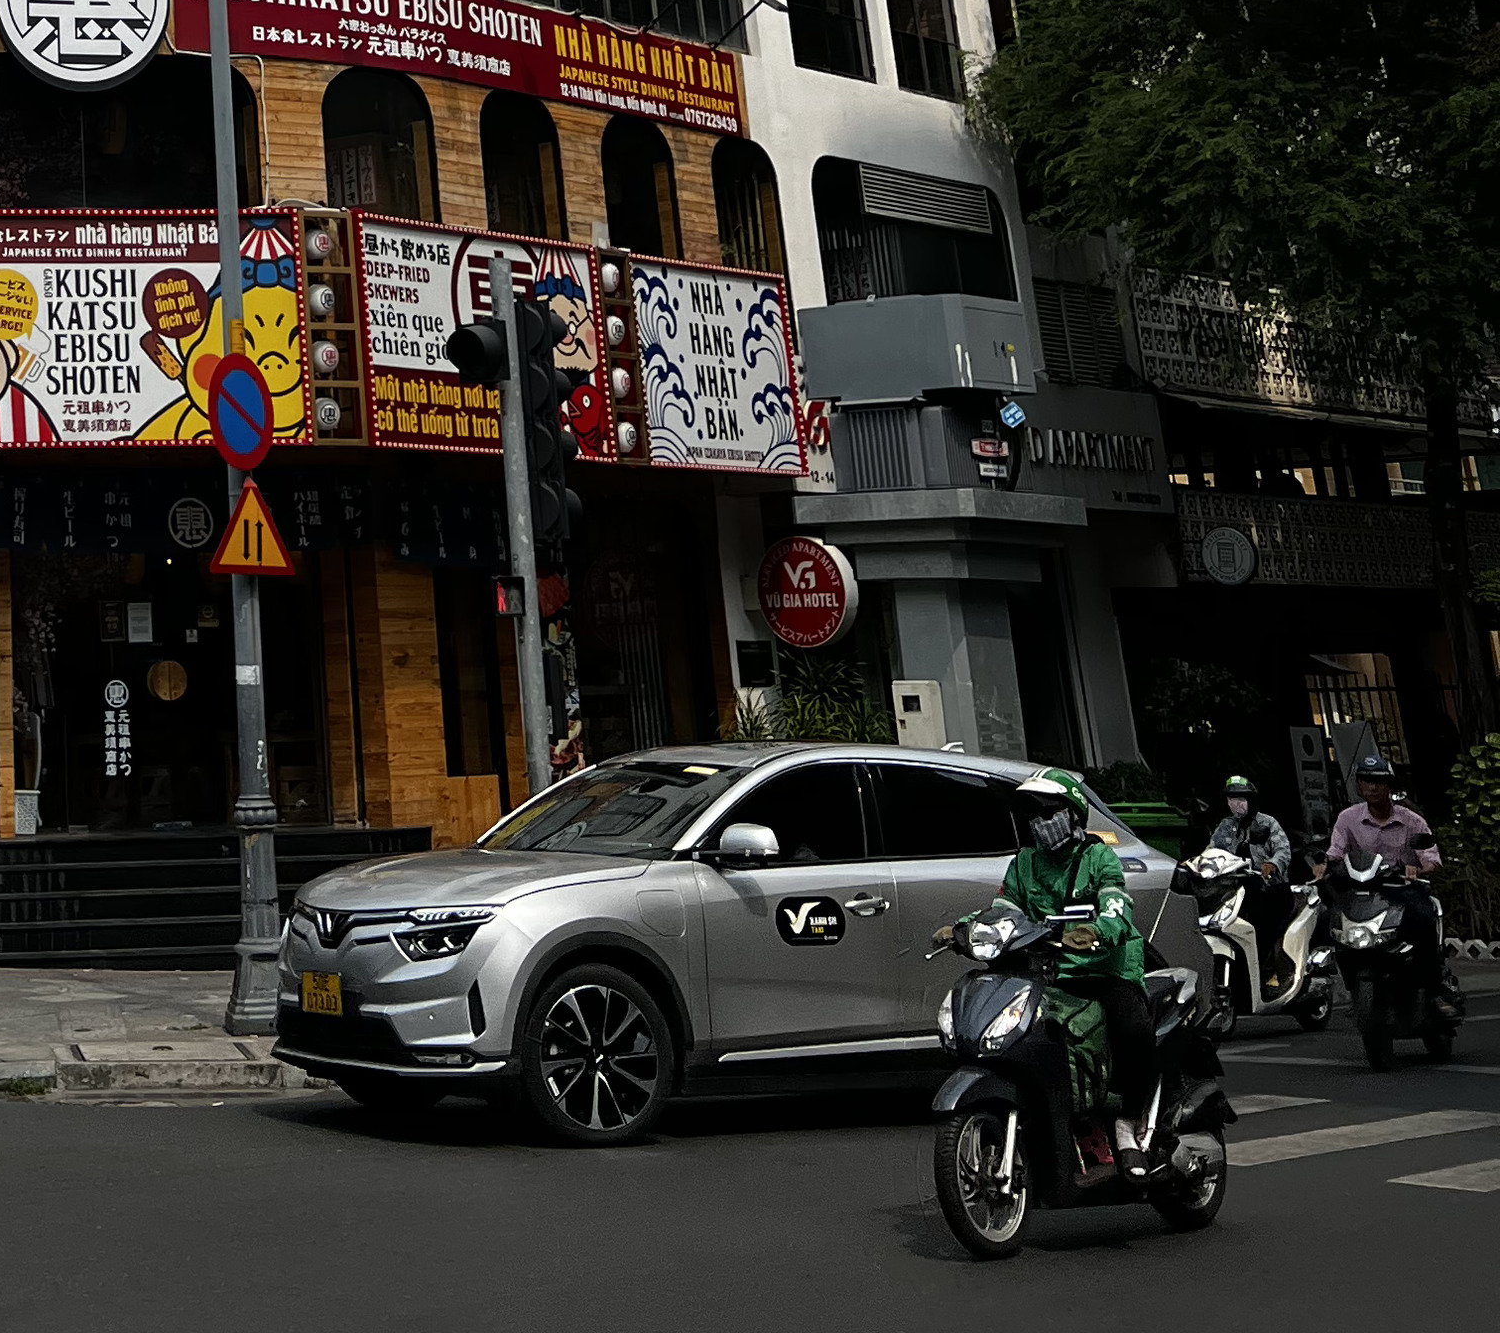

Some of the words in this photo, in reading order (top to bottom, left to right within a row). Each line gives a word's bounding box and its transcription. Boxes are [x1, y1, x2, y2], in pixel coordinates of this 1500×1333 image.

[400, 26, 447, 44] パラダイス
[468, 2, 544, 47] SHOTEN
[252, 25, 363, 50] 日本食レストラン
[367, 36, 442, 63] 元祖串かつ
[553, 23, 593, 63] NHÀ
[596, 31, 647, 75] HÀNG
[650, 45, 695, 89] NHẬT
[699, 51, 733, 95] BẢN
[559, 64, 610, 87] JAPANESE
[611, 76, 639, 94] STYLE
[640, 82, 676, 102] DINING
[677, 90, 735, 115] RESTAURANT
[684, 107, 737, 133] 0767229439
[75, 222, 107, 244] nhà
[111, 222, 151, 246] hàng
[156, 222, 195, 247] Nhật
[199, 220, 219, 244] Bả
[2, 246, 52, 258] JAPANESE
[55, 246, 83, 258] STYLE
[86, 247, 122, 258] DINING
[124, 247, 188, 258] RESTAURANT
[364, 233, 450, 266] 昼から飲める店
[43, 268, 53, 298] GANSO
[55, 268, 137, 298] KUSHI
[154, 278, 189, 296] Không
[366, 260, 430, 284] DEEP-FRIED
[154, 297, 177, 313] tính
[177, 291, 196, 310] phí
[368, 283, 419, 304] SKEWERS
[689, 275, 724, 317] NHÀ
[47, 300, 136, 331] KATSU
[158, 313, 183, 331] dịch
[369, 303, 408, 329] xiên
[412, 314, 444, 338] que
[54, 333, 131, 363] EBISU
[372, 331, 421, 357] chiên
[689, 314, 735, 358] HÀNG
[46, 365, 141, 395] SHOTEN
[374, 374, 401, 406] Một
[403, 378, 428, 404] nhà
[429, 379, 461, 409] hàng
[464, 384, 484, 409] nơi
[695, 358, 738, 406] NHẬT
[62, 400, 131, 415] 元祖串かつ
[377, 404, 394, 431] có
[397, 403, 418, 433] thể
[421, 407, 453, 438] uống
[455, 410, 469, 437] từ
[472, 414, 500, 439] trưa
[1049, 428, 1155, 471] APARTMENT
[63, 490, 77, 548] 生ビール
[762, 544, 790, 588] SERVICED
[792, 542, 841, 587] APARTMENT
[766, 590, 782, 608] VŨ
[783, 592, 802, 608] GIA
[804, 592, 839, 608] HOTEL
[117, 710, 132, 777] 元祖串かつ
